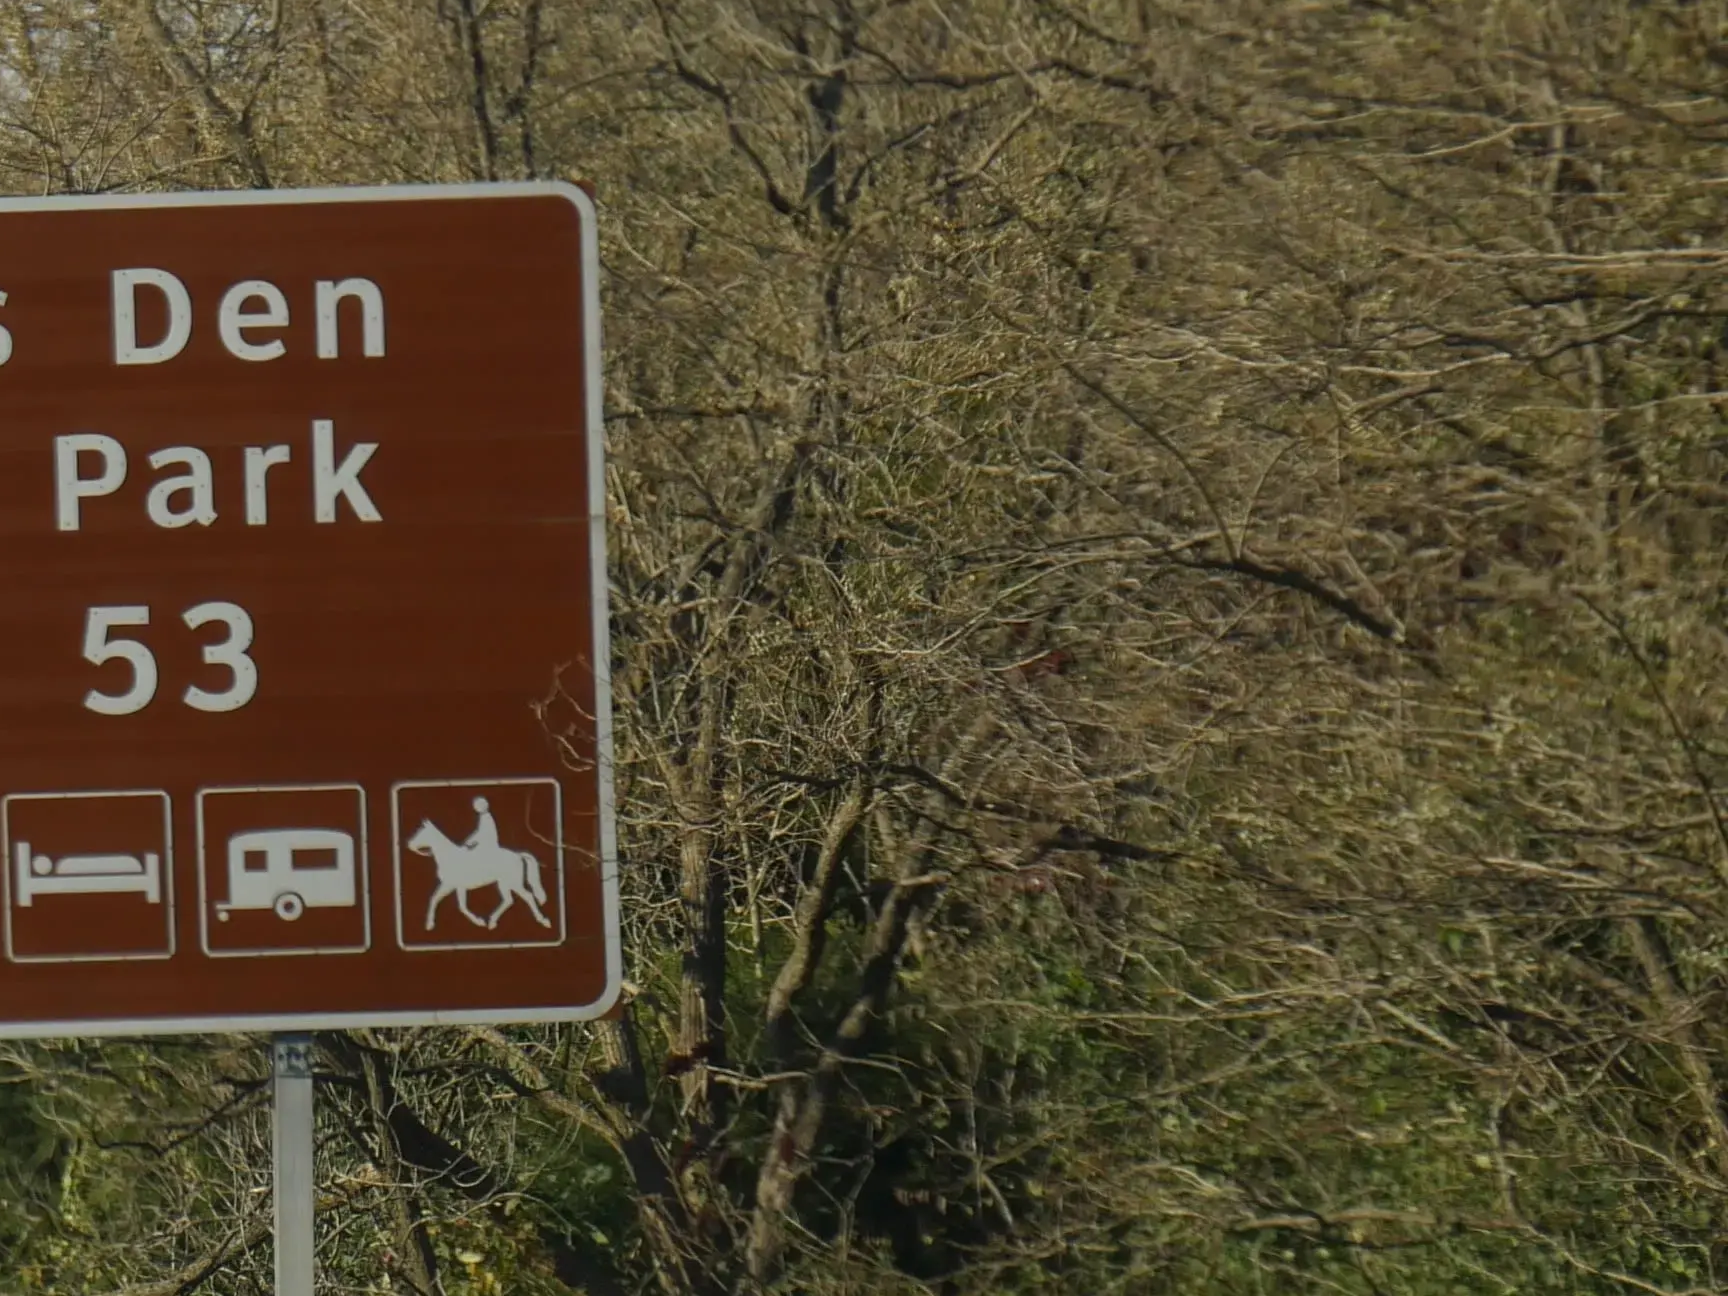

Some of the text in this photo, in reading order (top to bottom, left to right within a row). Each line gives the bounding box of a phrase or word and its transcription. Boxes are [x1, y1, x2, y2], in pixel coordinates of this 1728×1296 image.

[112, 266, 386, 366] Den
[54, 419, 383, 532] Park
[82, 601, 258, 716] 53
